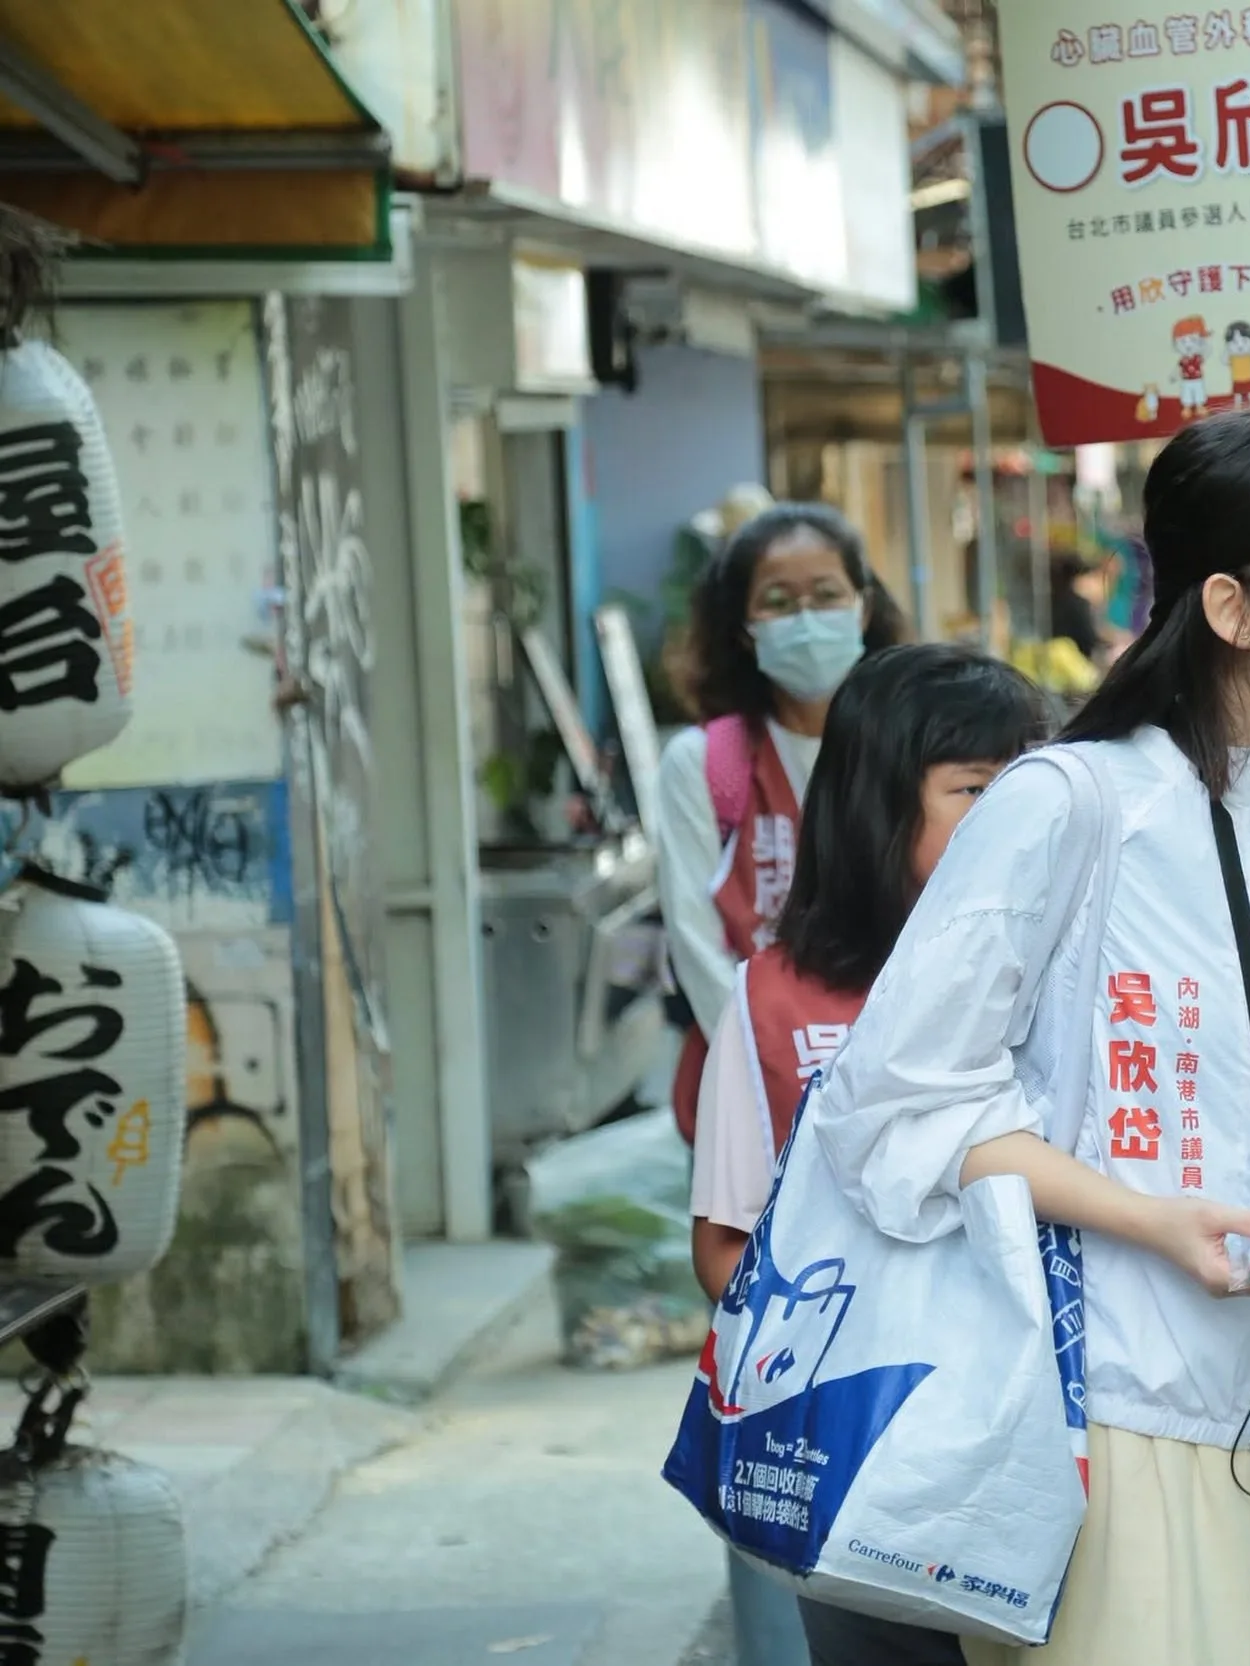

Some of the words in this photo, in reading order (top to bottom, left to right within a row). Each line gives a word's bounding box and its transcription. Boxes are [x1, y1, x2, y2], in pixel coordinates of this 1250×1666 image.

[0, 957, 124, 1258] おでん
[1108, 971, 1162, 1162] 吳欣岱
[848, 1538, 923, 1573] Carrefour
